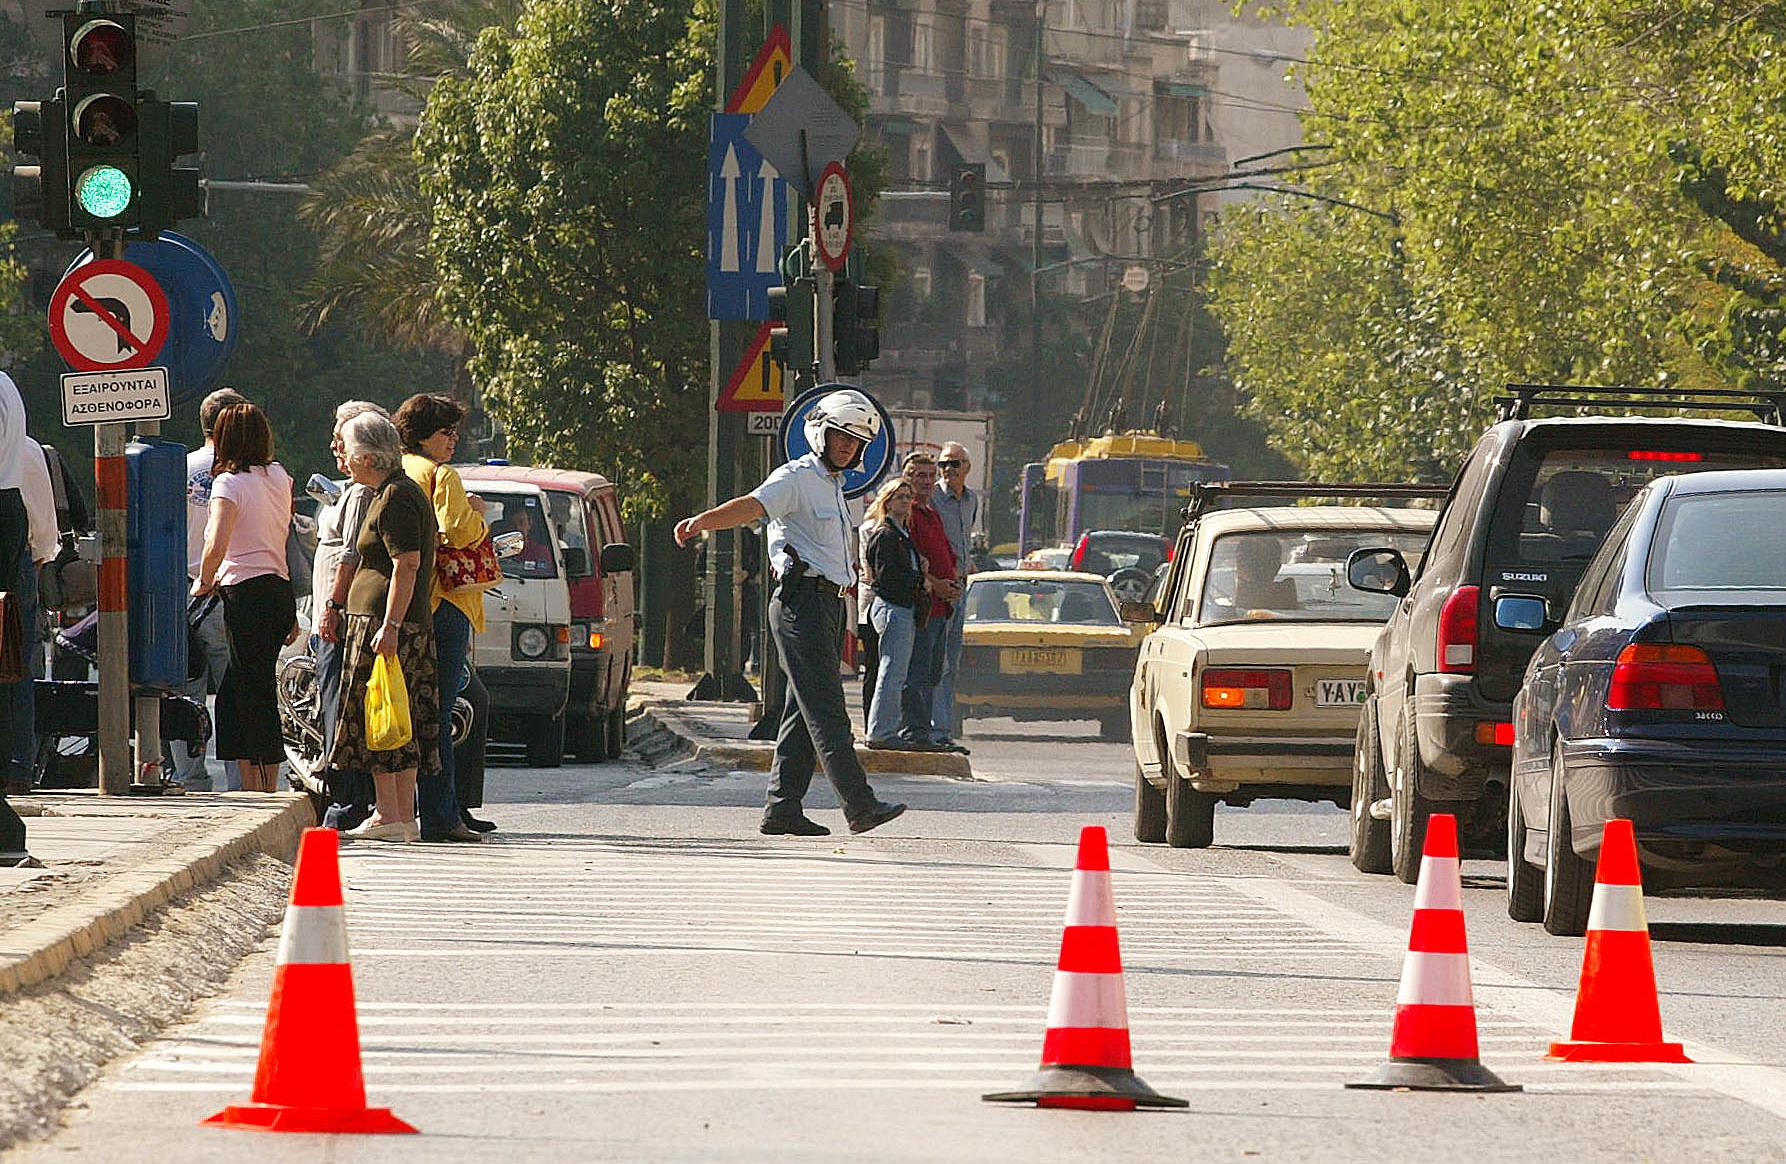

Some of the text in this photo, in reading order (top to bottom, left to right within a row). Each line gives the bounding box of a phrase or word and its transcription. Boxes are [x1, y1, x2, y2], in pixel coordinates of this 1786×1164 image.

[73, 380, 157, 395] ΕΞΑΙΡΟΥΝΤΑΙ
[72, 399, 161, 414] ΑΣΘΕΝΟΦΟΡΑ
[1502, 572, 1548, 582] SUZUKI
